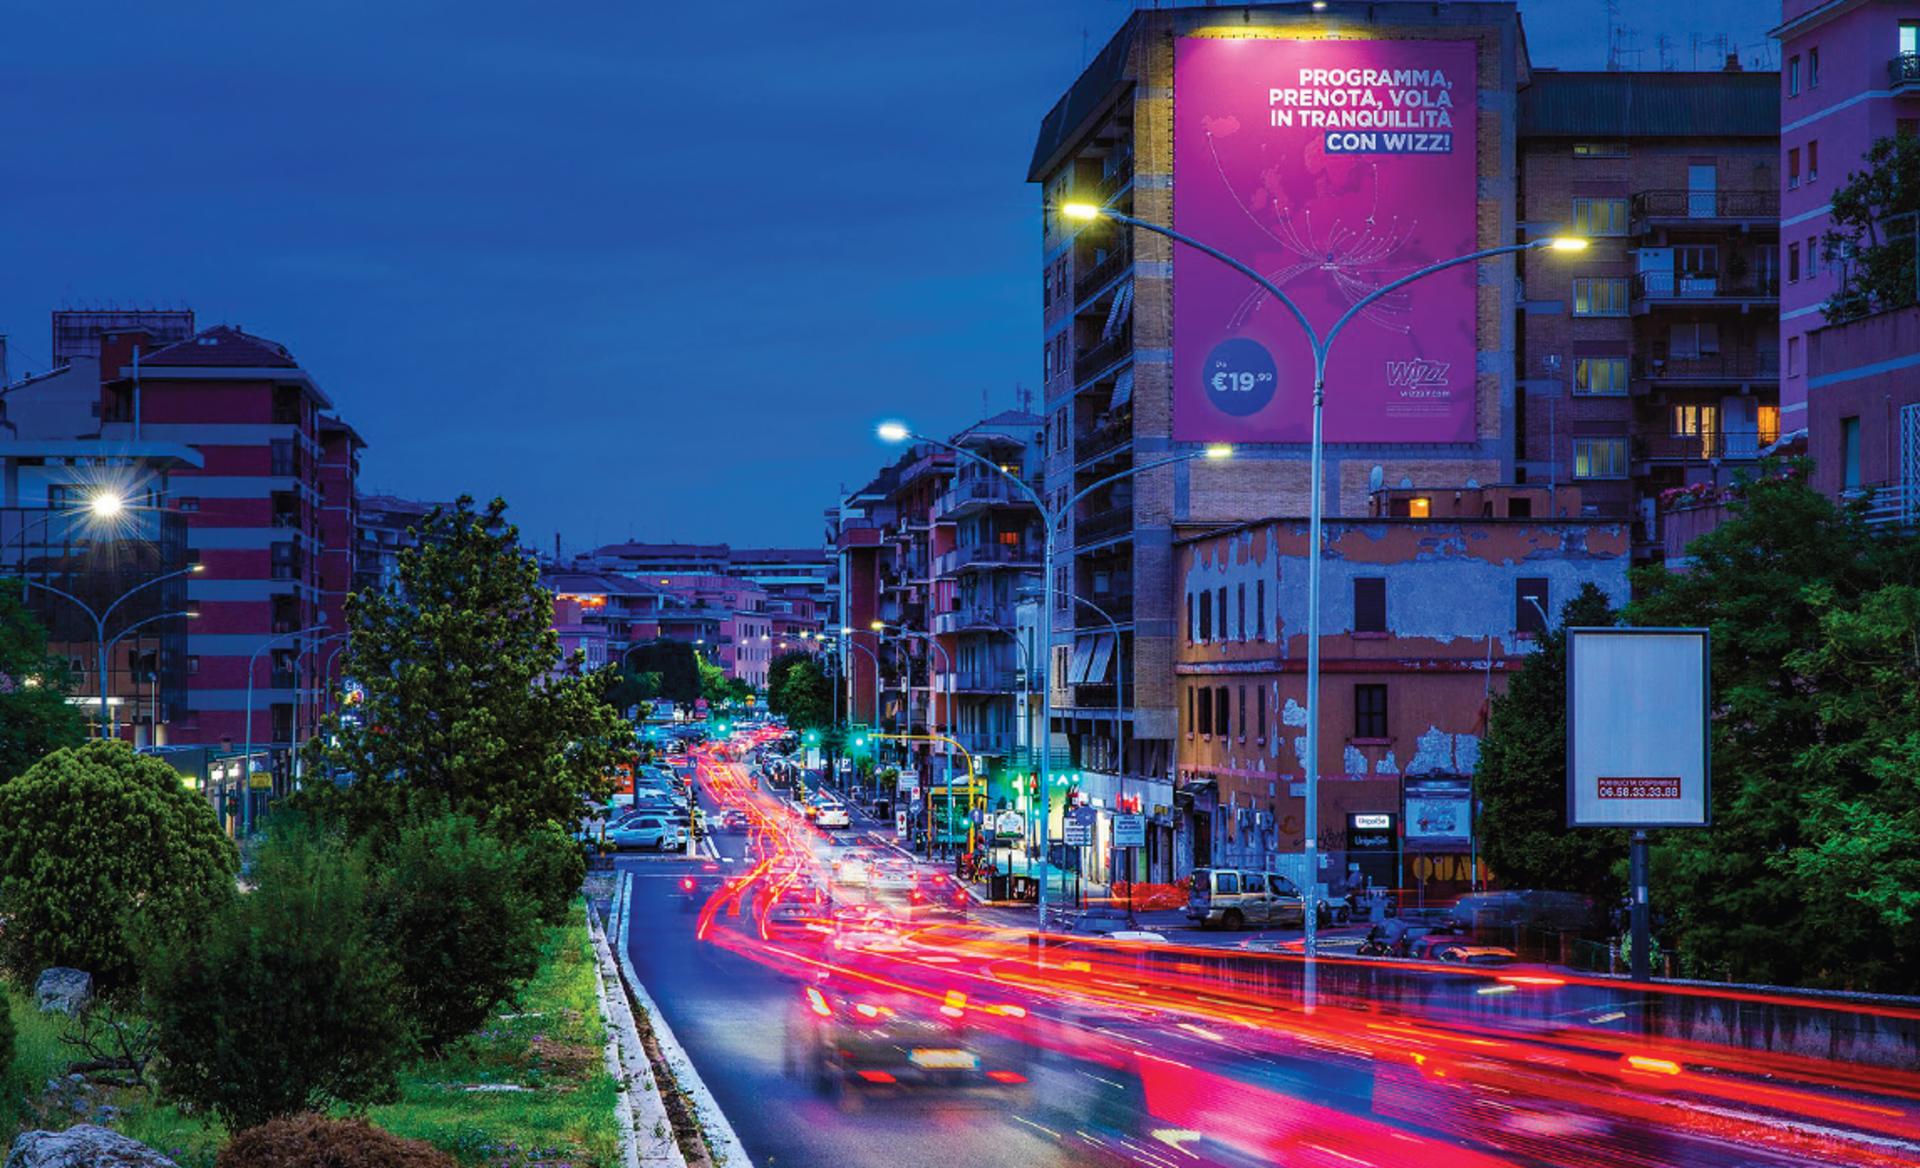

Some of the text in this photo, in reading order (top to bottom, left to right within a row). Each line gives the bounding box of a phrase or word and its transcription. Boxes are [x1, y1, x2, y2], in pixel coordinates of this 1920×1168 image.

[1300, 69, 1453, 88] PROGRAMMA,
[1269, 89, 1453, 109] PRENOTA, VOLA
[1271, 106, 1453, 128] IN TRANQUILLITÀ
[1327, 133, 1451, 151] CON WIZZ!
